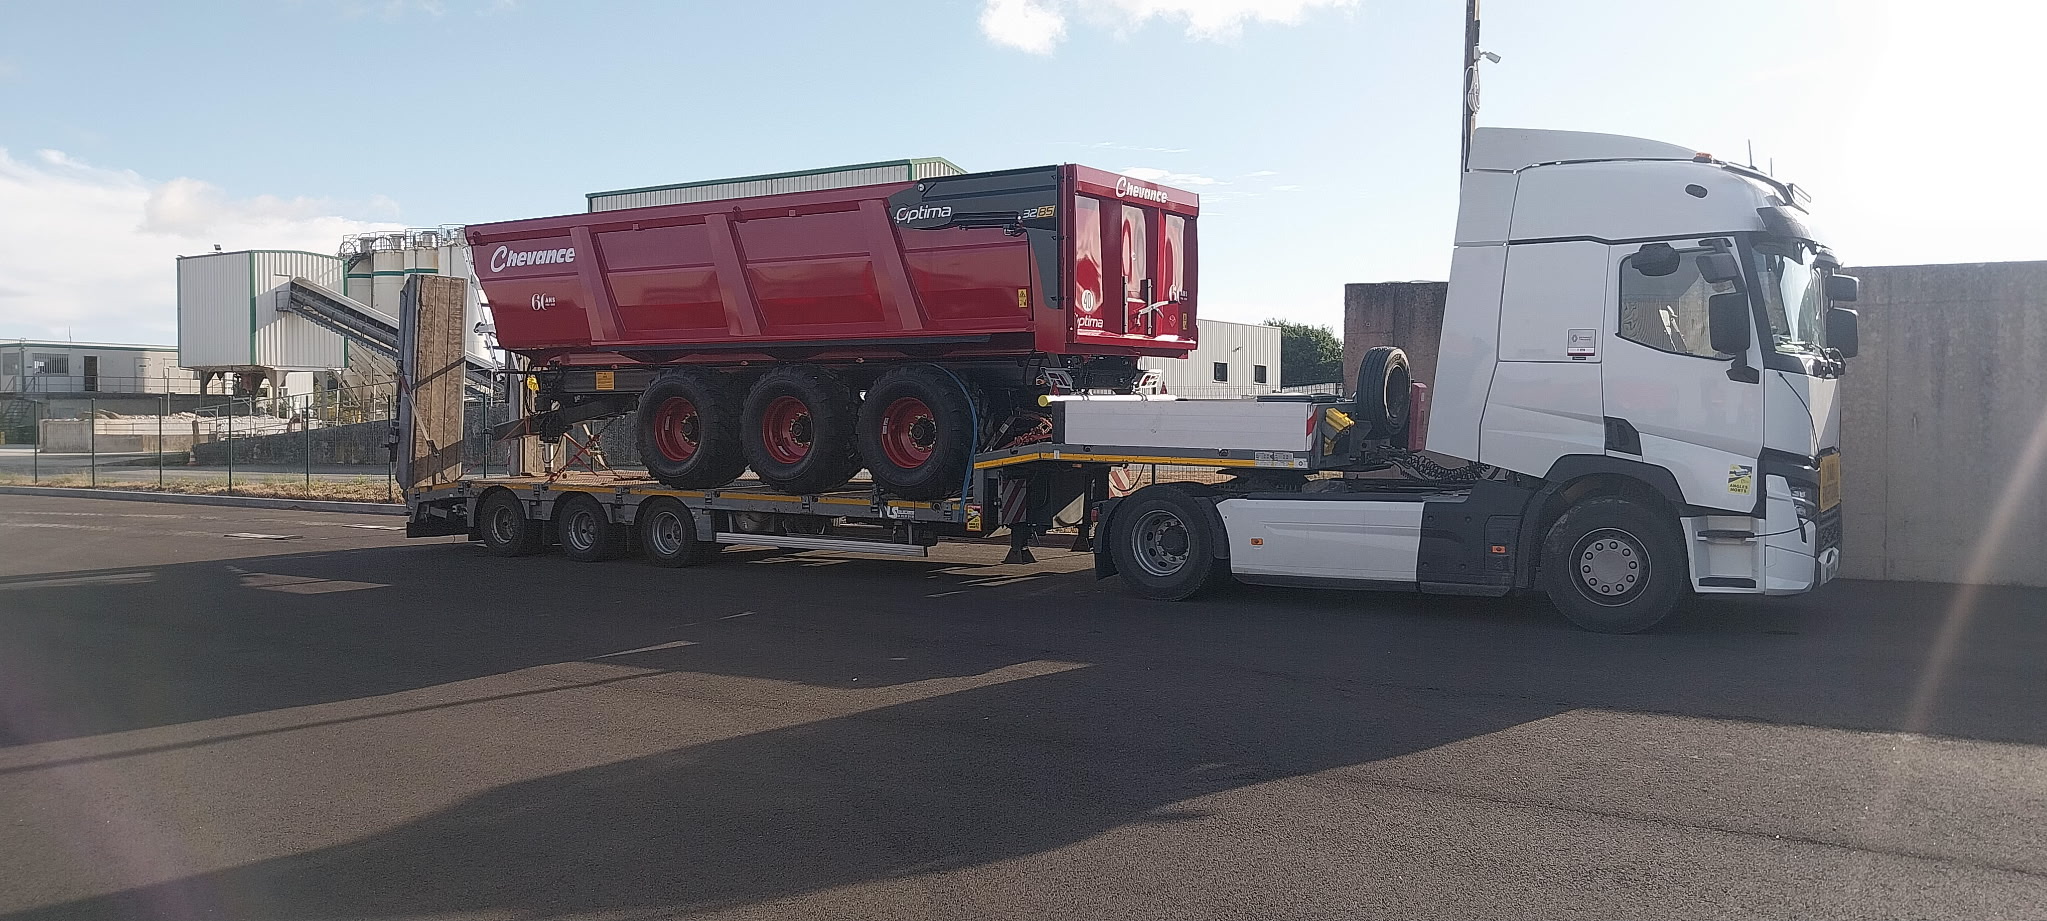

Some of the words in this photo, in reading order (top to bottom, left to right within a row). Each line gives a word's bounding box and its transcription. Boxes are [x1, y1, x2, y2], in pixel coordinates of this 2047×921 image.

[1116, 176, 1168, 203] Chevance
[894, 206, 951, 223] Optima
[490, 245, 576, 273] Chevance
[1083, 292, 1092, 309] 40
